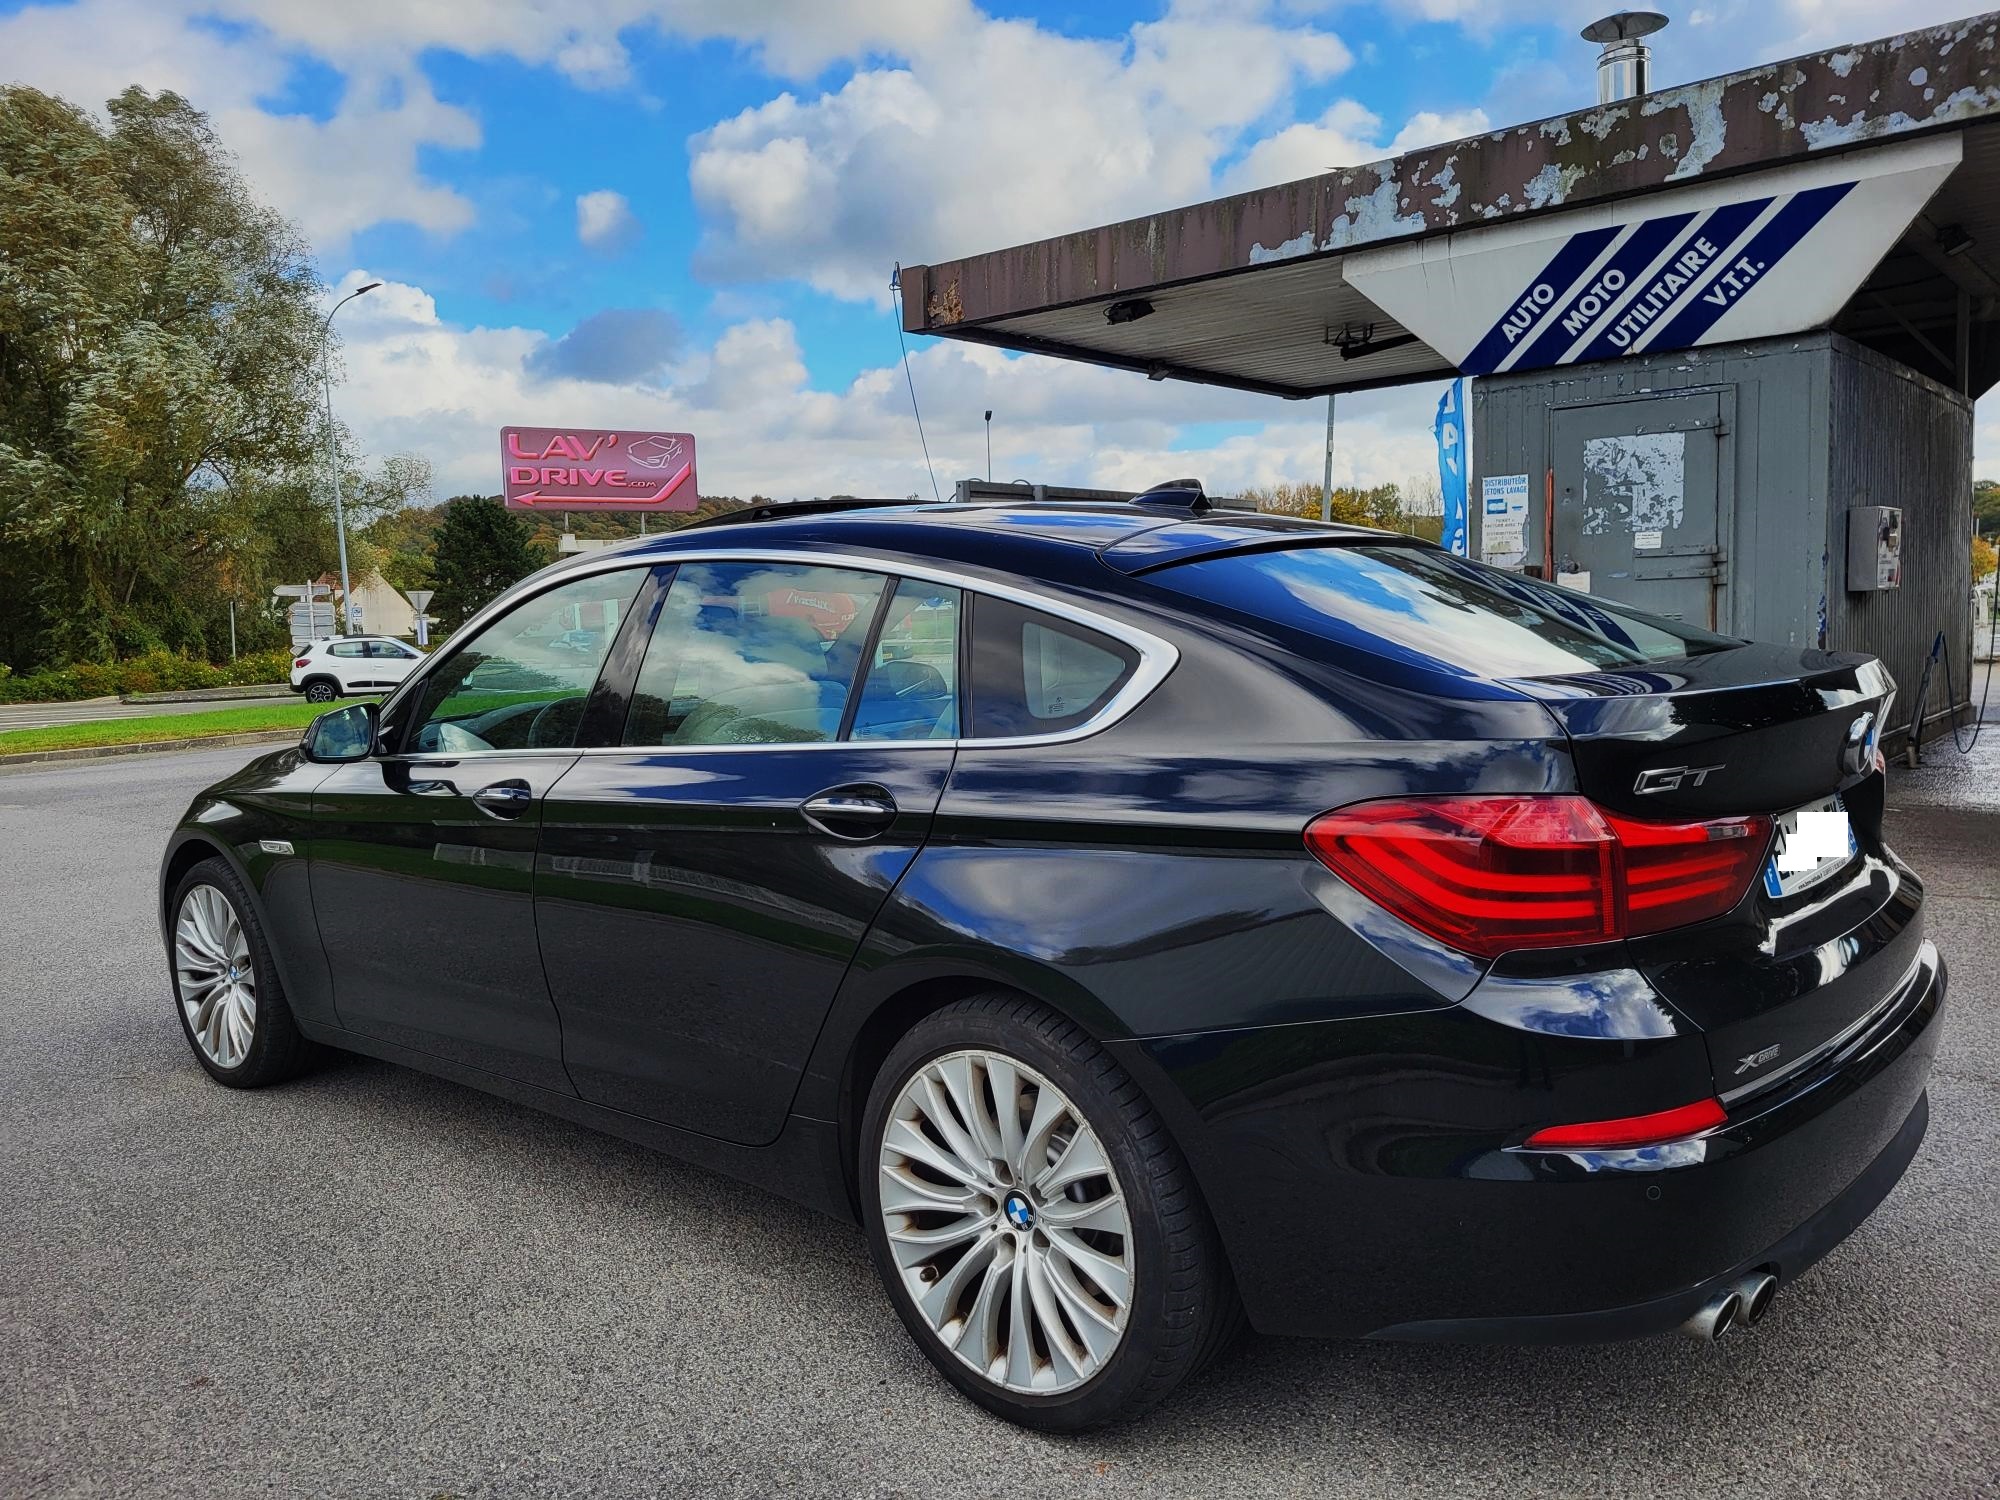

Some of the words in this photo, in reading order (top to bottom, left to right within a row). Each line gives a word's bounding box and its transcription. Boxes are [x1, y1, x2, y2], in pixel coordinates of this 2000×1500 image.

[1562, 268, 1626, 337] MOTO
[1607, 236, 1718, 348] UTILITAIRE
[1703, 256, 1766, 308] V.T.T.
[1502, 283, 1555, 343] AUTO
[508, 433, 619, 461] LAV'
[1484, 487, 1505, 496] JETONS
[1506, 485, 1527, 495] LAVAGE
[1633, 763, 1727, 796] GT
